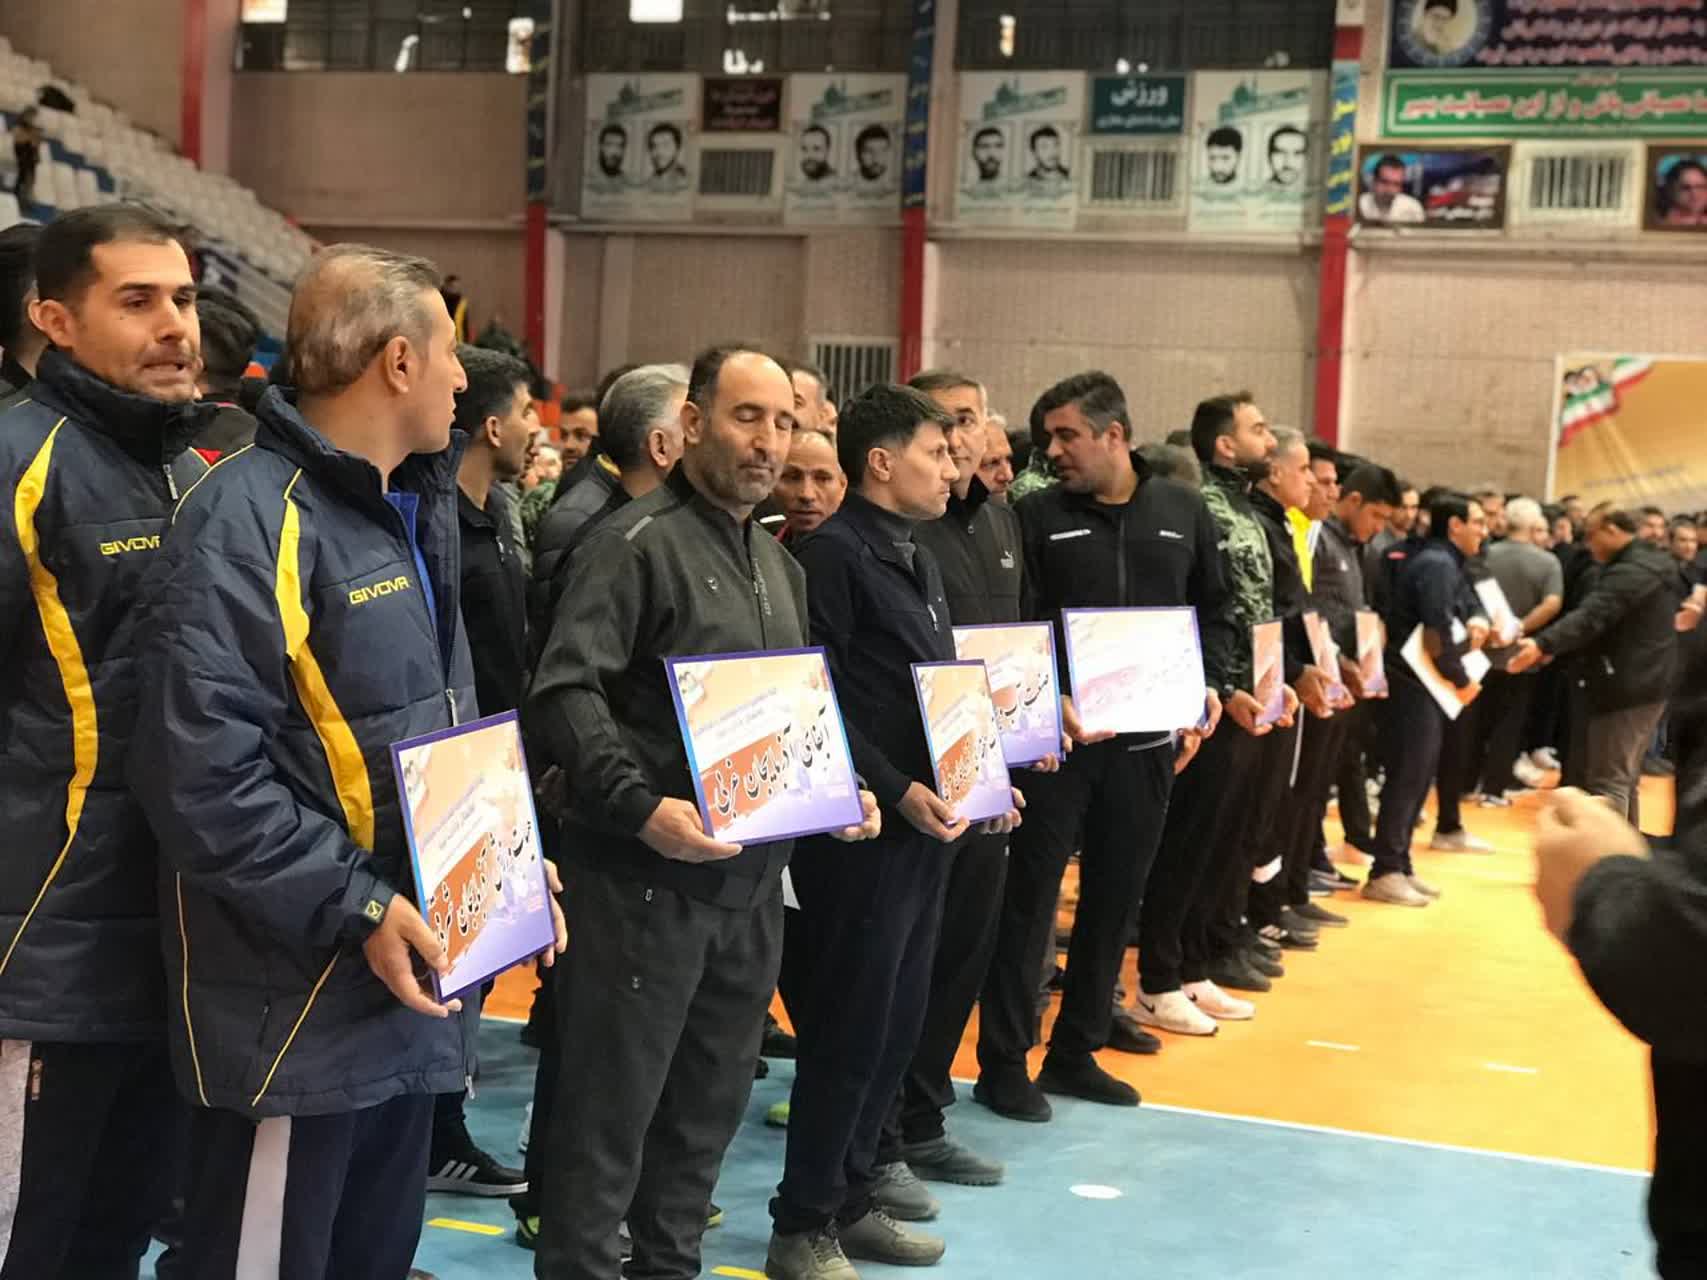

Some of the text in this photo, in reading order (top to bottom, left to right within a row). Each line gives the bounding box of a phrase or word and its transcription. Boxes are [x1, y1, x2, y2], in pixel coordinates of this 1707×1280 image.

[1110, 80, 1169, 107] ورزش
[349, 576, 410, 605] GIVOVA
[742, 720, 795, 800] آذربایجان
[714, 757, 739, 819] غربی
